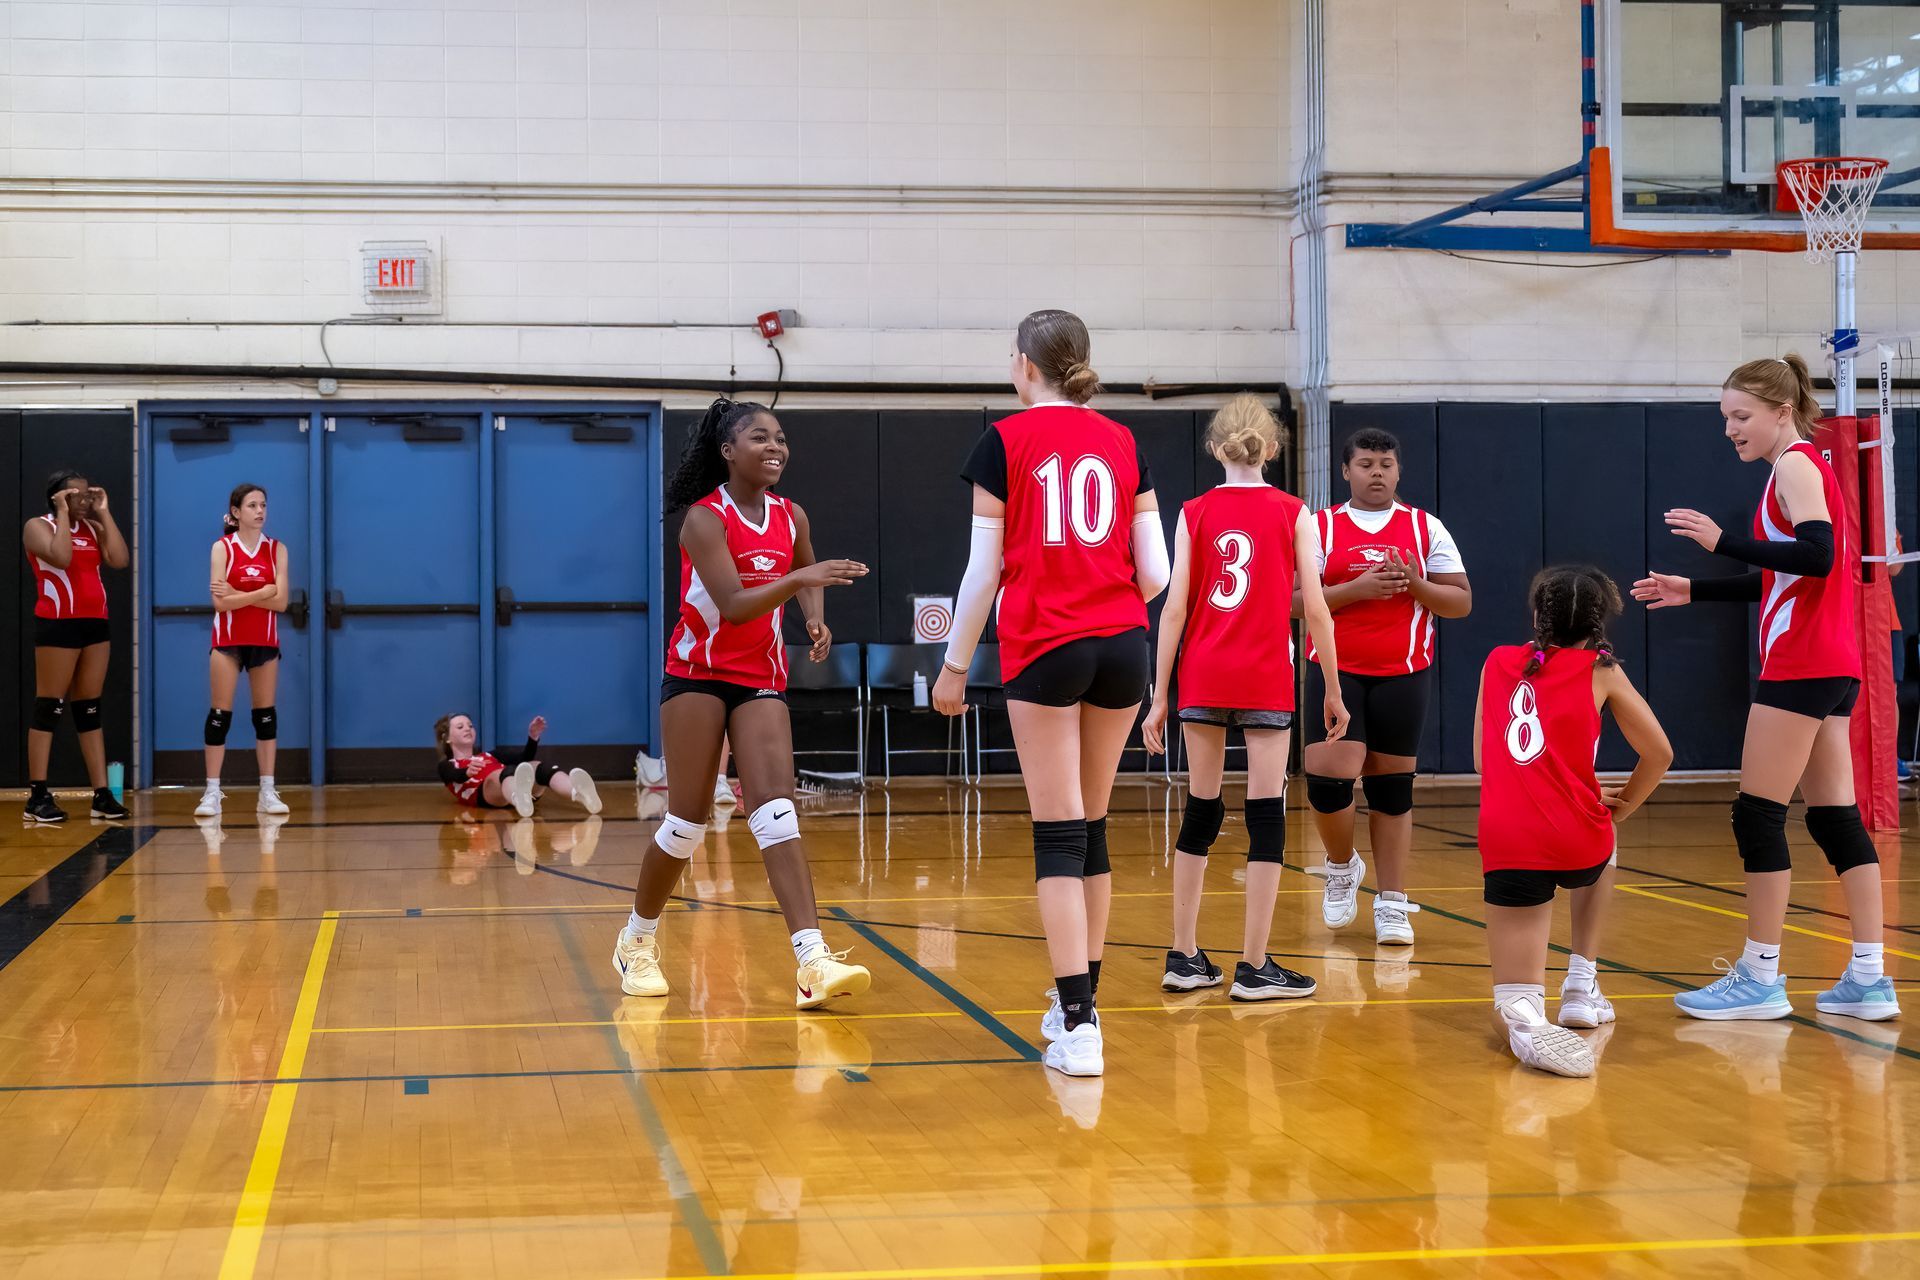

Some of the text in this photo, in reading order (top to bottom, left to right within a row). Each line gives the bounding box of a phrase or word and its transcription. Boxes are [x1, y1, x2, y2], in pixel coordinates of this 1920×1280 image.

[378, 259, 416, 288] EXIT
[1032, 452, 1116, 547] 10
[1207, 529, 1255, 612] 3
[1504, 680, 1546, 766] 8
